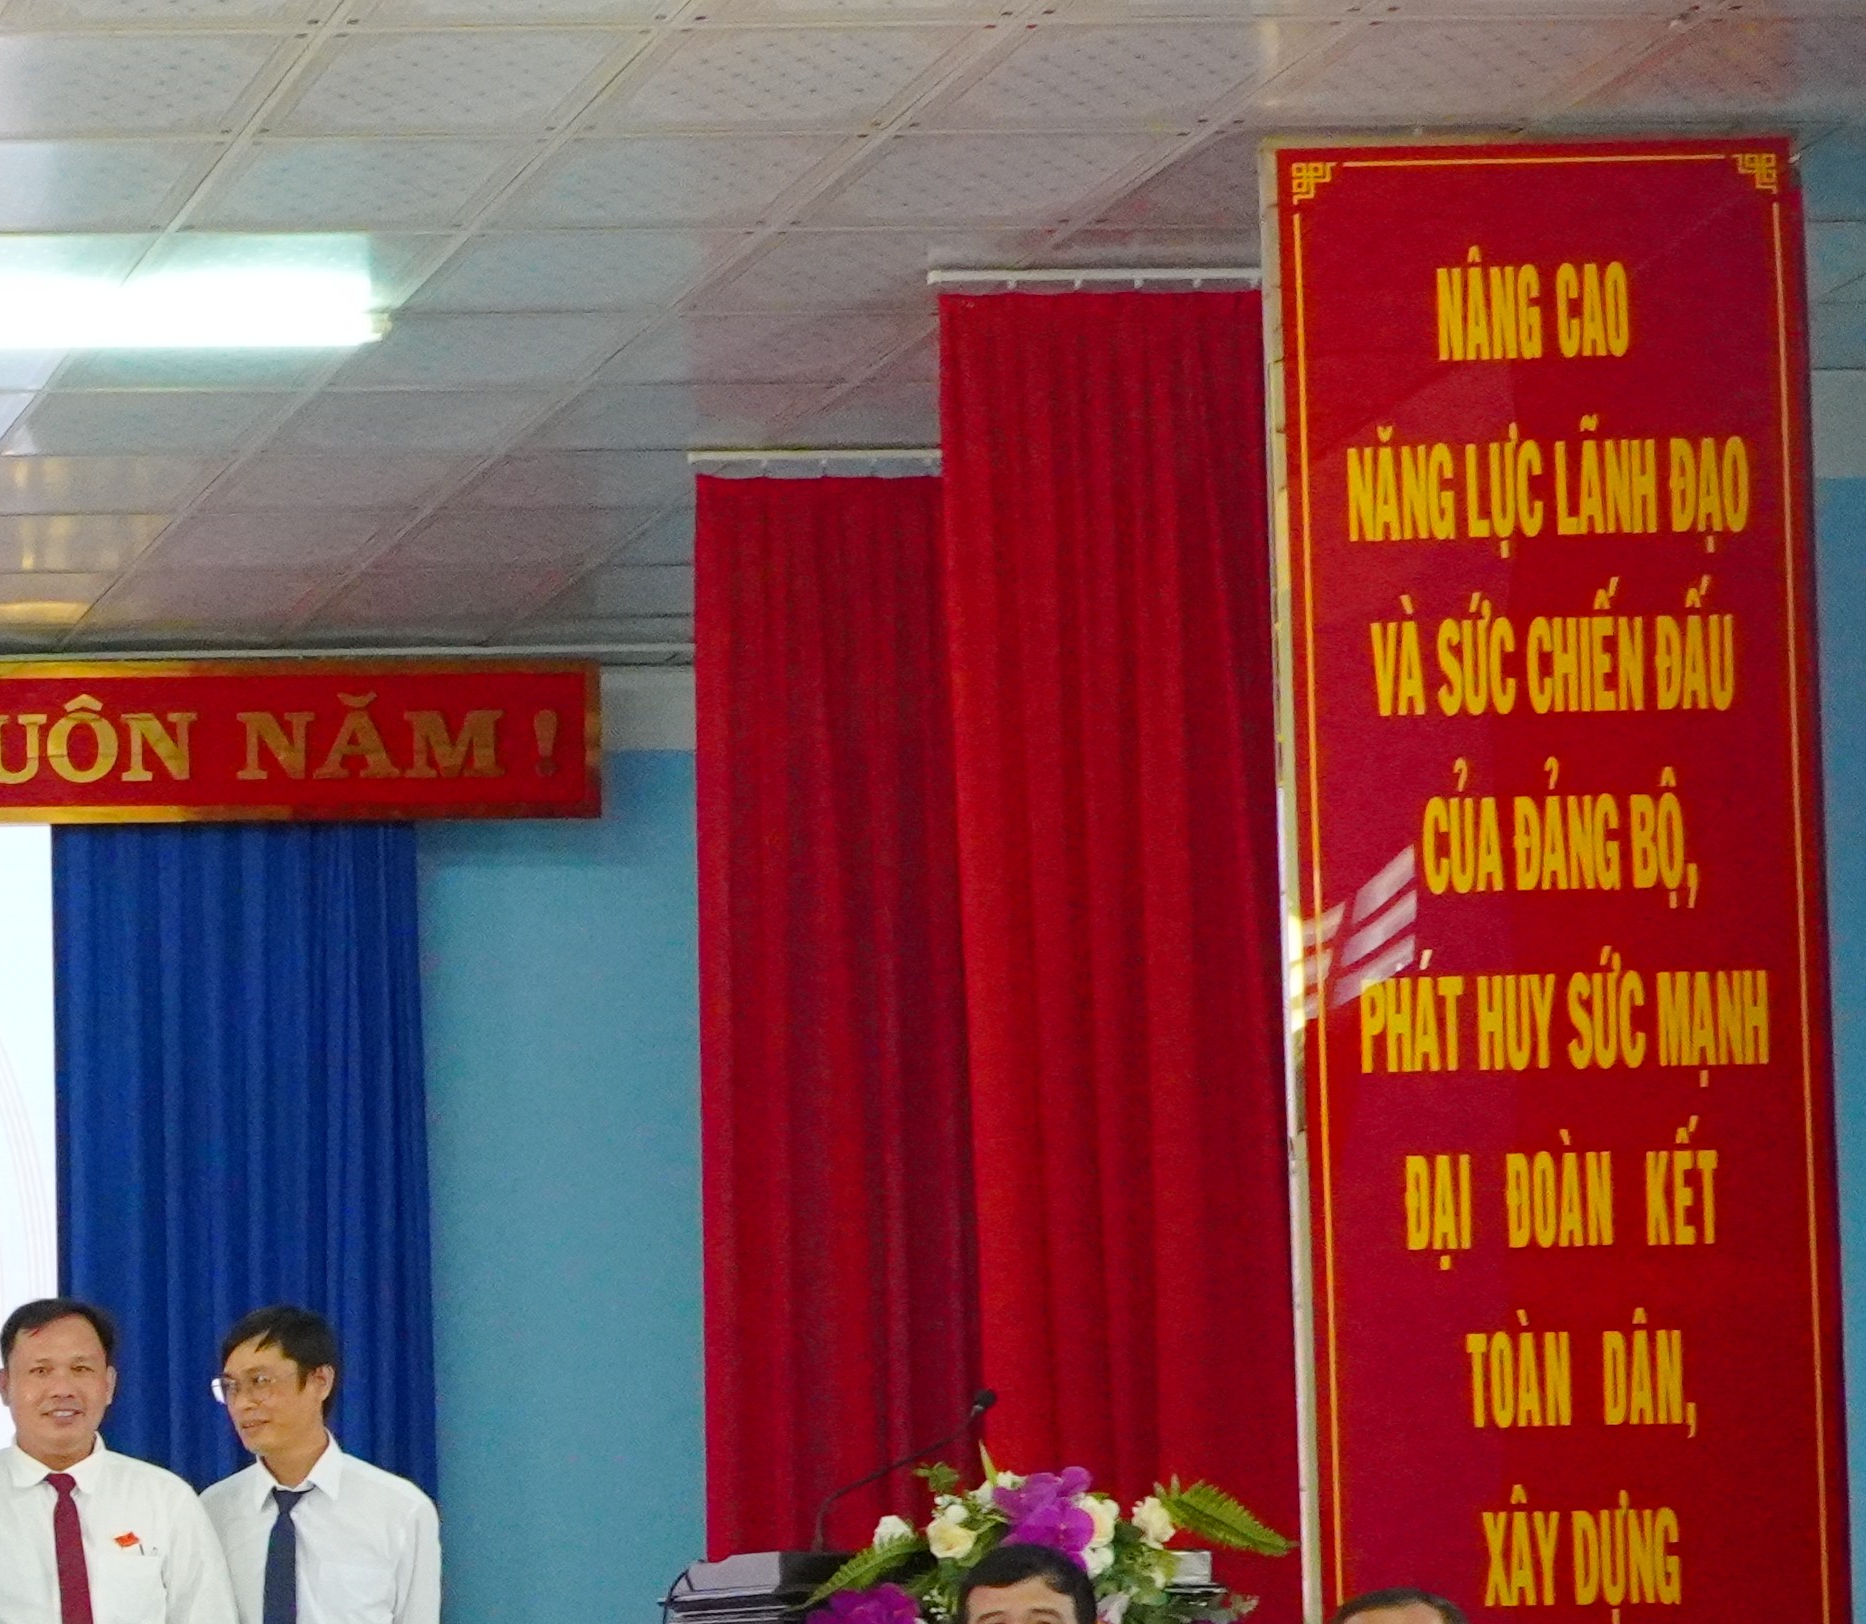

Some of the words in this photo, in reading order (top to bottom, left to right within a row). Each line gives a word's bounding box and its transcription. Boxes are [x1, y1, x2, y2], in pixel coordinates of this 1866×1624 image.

[1437, 246, 1542, 361] NÂNG
[1556, 262, 1629, 357] CAO
[1347, 426, 1456, 541] NĂNG
[1465, 425, 1543, 557] LỰC
[1555, 415, 1657, 535] LÃNH
[1669, 437, 1748, 550] ĐẠO
[1370, 595, 1426, 716] VÀ
[1437, 592, 1516, 716] SỨC
[1527, 578, 1643, 714] CHIẾN
[1655, 577, 1734, 710] ĐẤU
[236, 692, 505, 780] NĂM
[1423, 759, 1504, 894] CỦA
[1514, 757, 1620, 890] ĐẢNG
[1630, 767, 1697, 907] BỘ,
[1360, 951, 1464, 1073] PHÁT
[1477, 974, 1555, 1070] HUY
[1568, 947, 1645, 1069] SỨC
[1657, 970, 1768, 1085] MẠNH
[1405, 1154, 1471, 1270] ĐẠI
[1506, 1129, 1613, 1248] ĐOÀN
[1646, 1116, 1717, 1245] KẾT
[1467, 1309, 1571, 1428] TOÀN
[1603, 1308, 1696, 1435] DÂN,
[1483, 1485, 1559, 1606] XÂY
[1572, 1491, 1680, 1624] DỰNG
